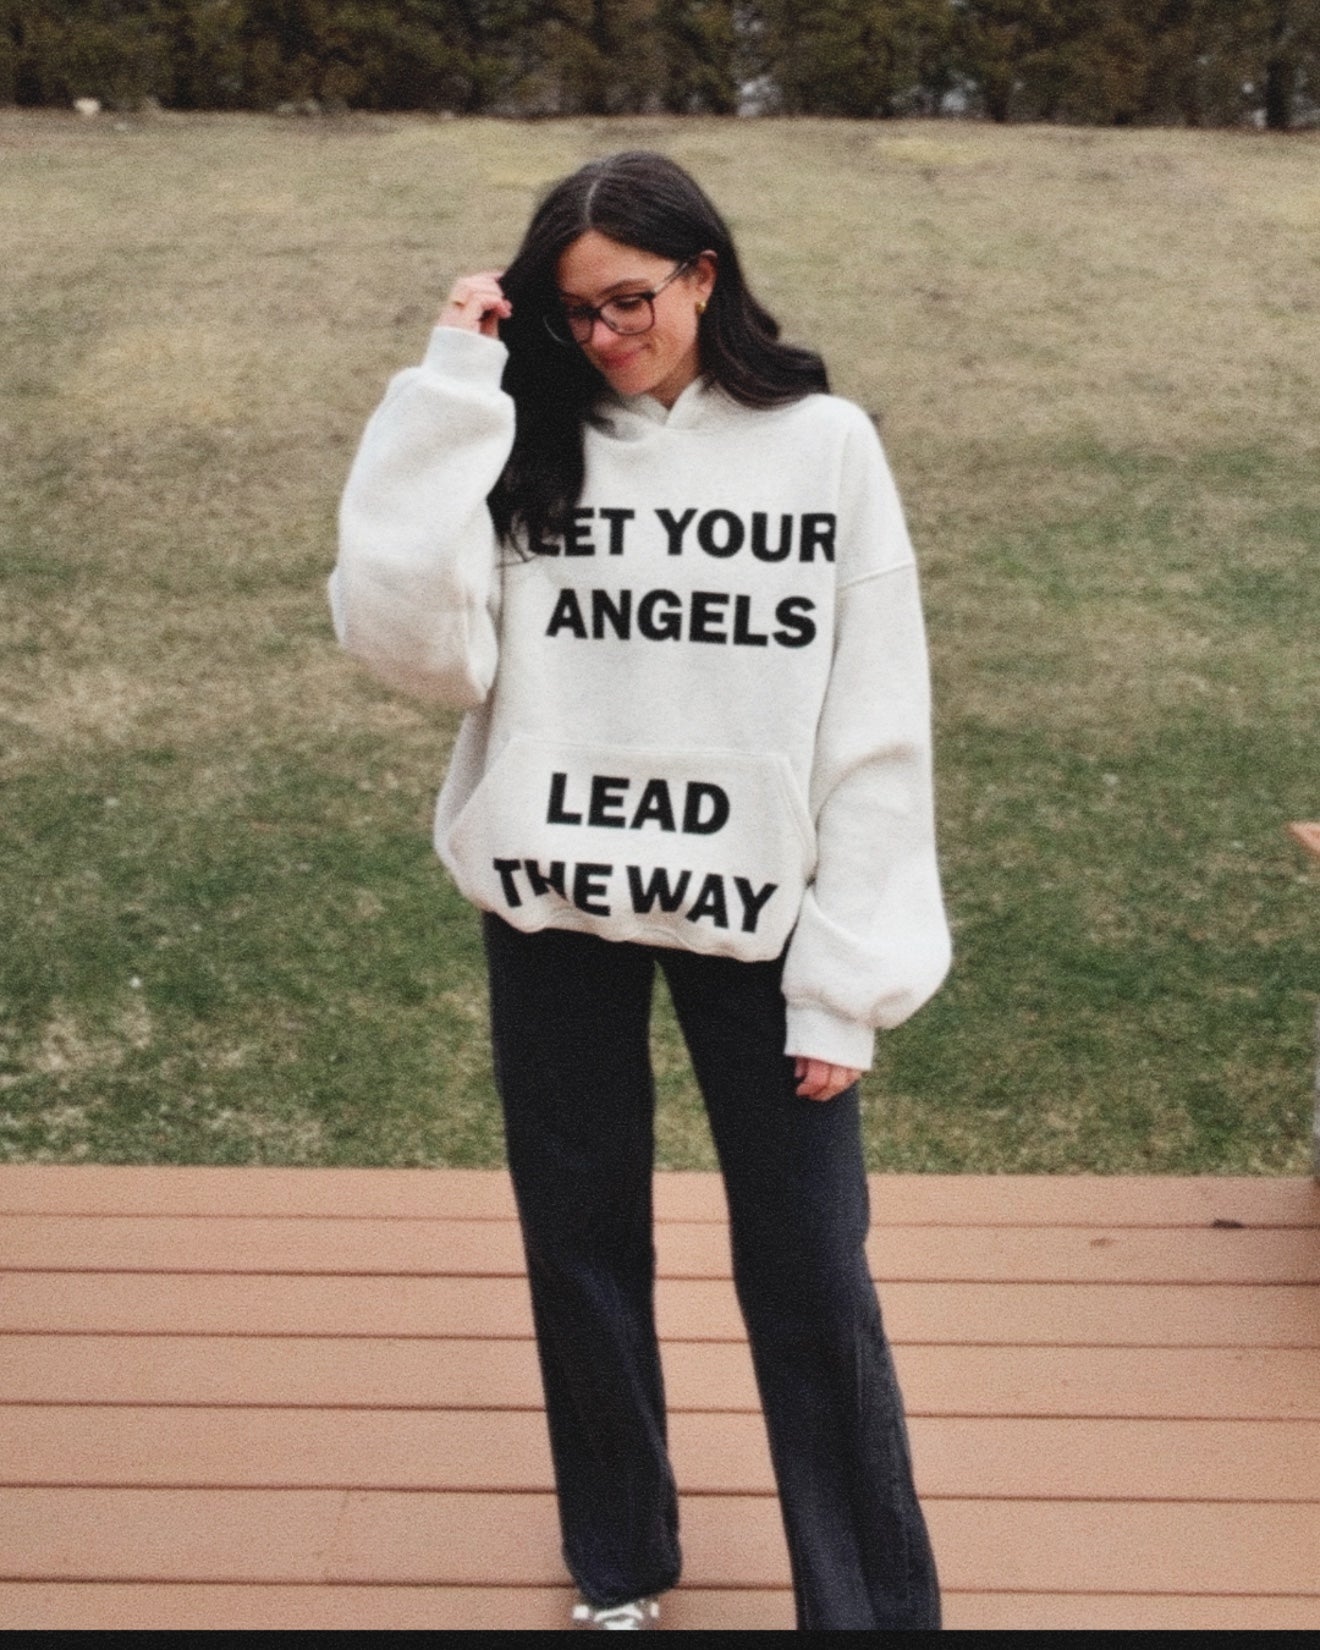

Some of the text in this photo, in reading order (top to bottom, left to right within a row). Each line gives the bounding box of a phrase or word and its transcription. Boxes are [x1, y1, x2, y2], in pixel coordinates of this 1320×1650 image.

[654, 508, 836, 562] YOUR
[546, 588, 816, 648] ANGELS
[547, 772, 730, 835] LEAD
[493, 857, 778, 933] THE WAY
